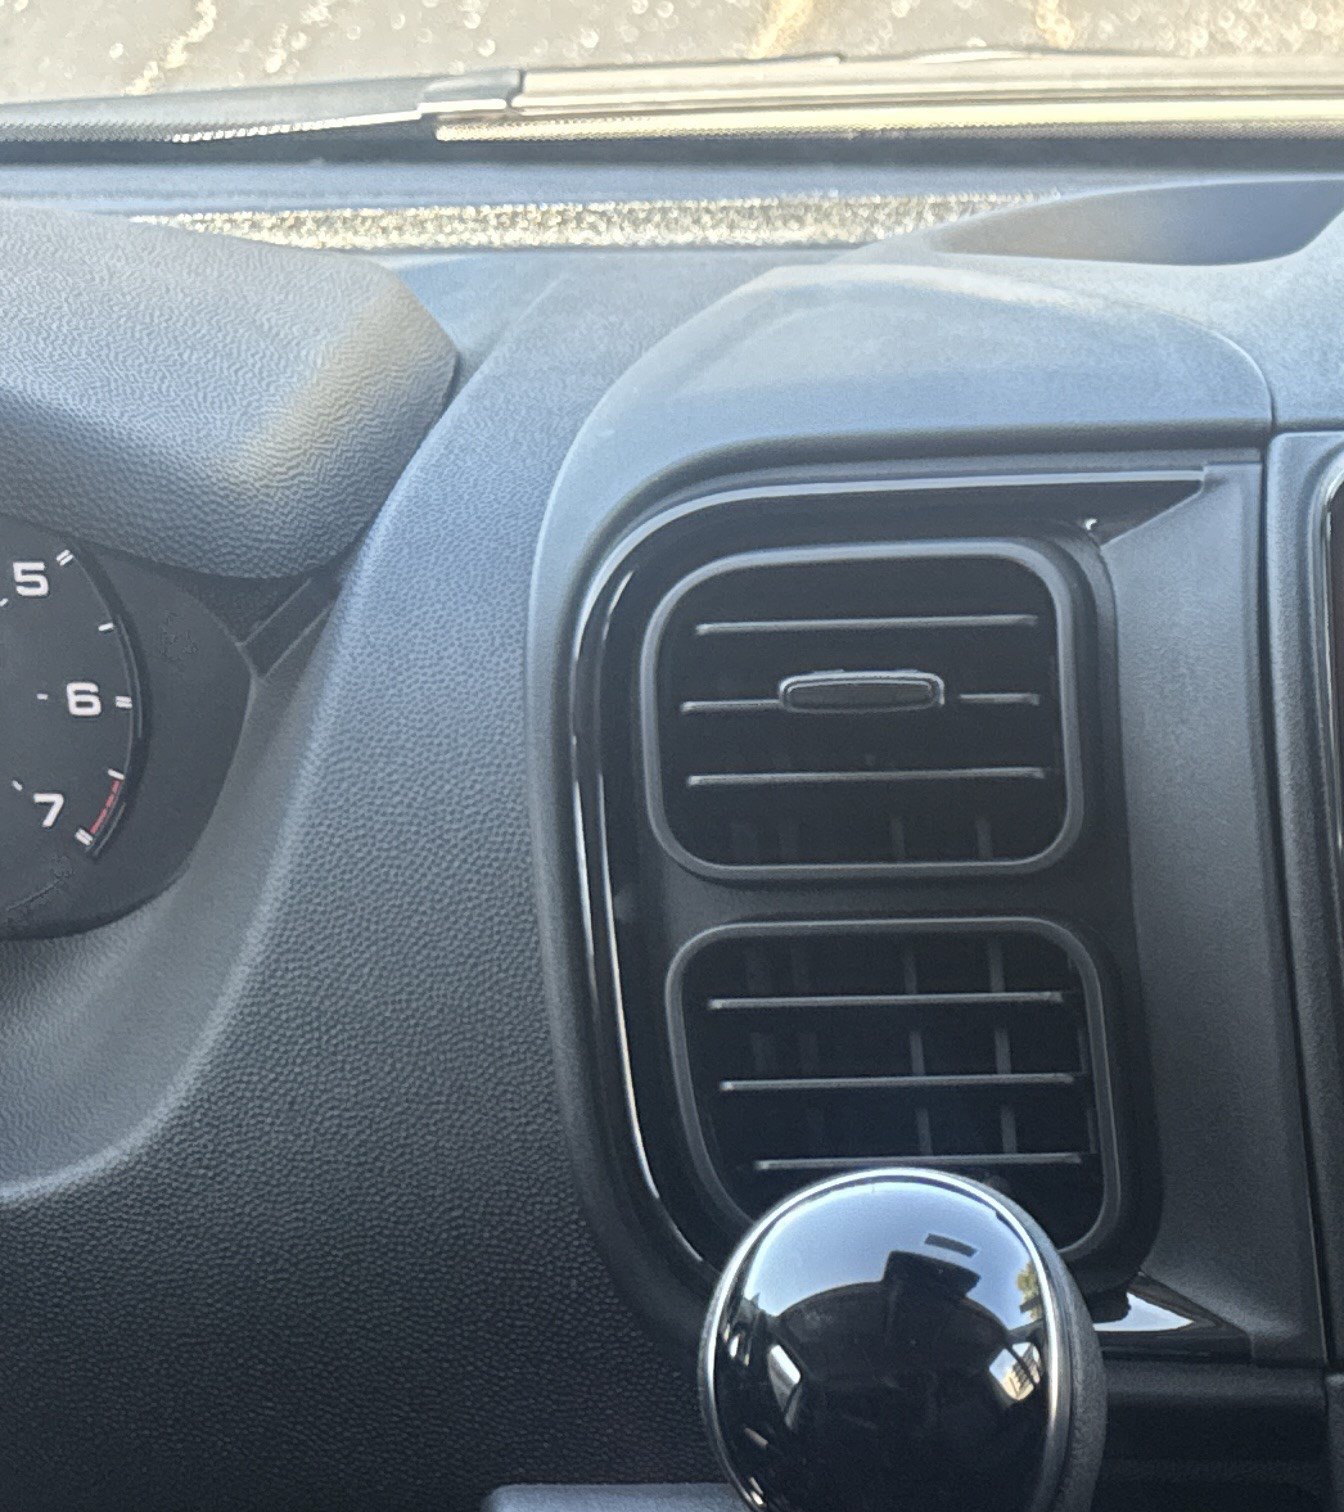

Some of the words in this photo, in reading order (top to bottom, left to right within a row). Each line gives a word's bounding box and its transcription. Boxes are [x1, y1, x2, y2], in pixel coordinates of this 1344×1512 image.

[12, 561, 49, 596] 5
[66, 682, 102, 716] 6
[33, 793, 65, 827] 7
